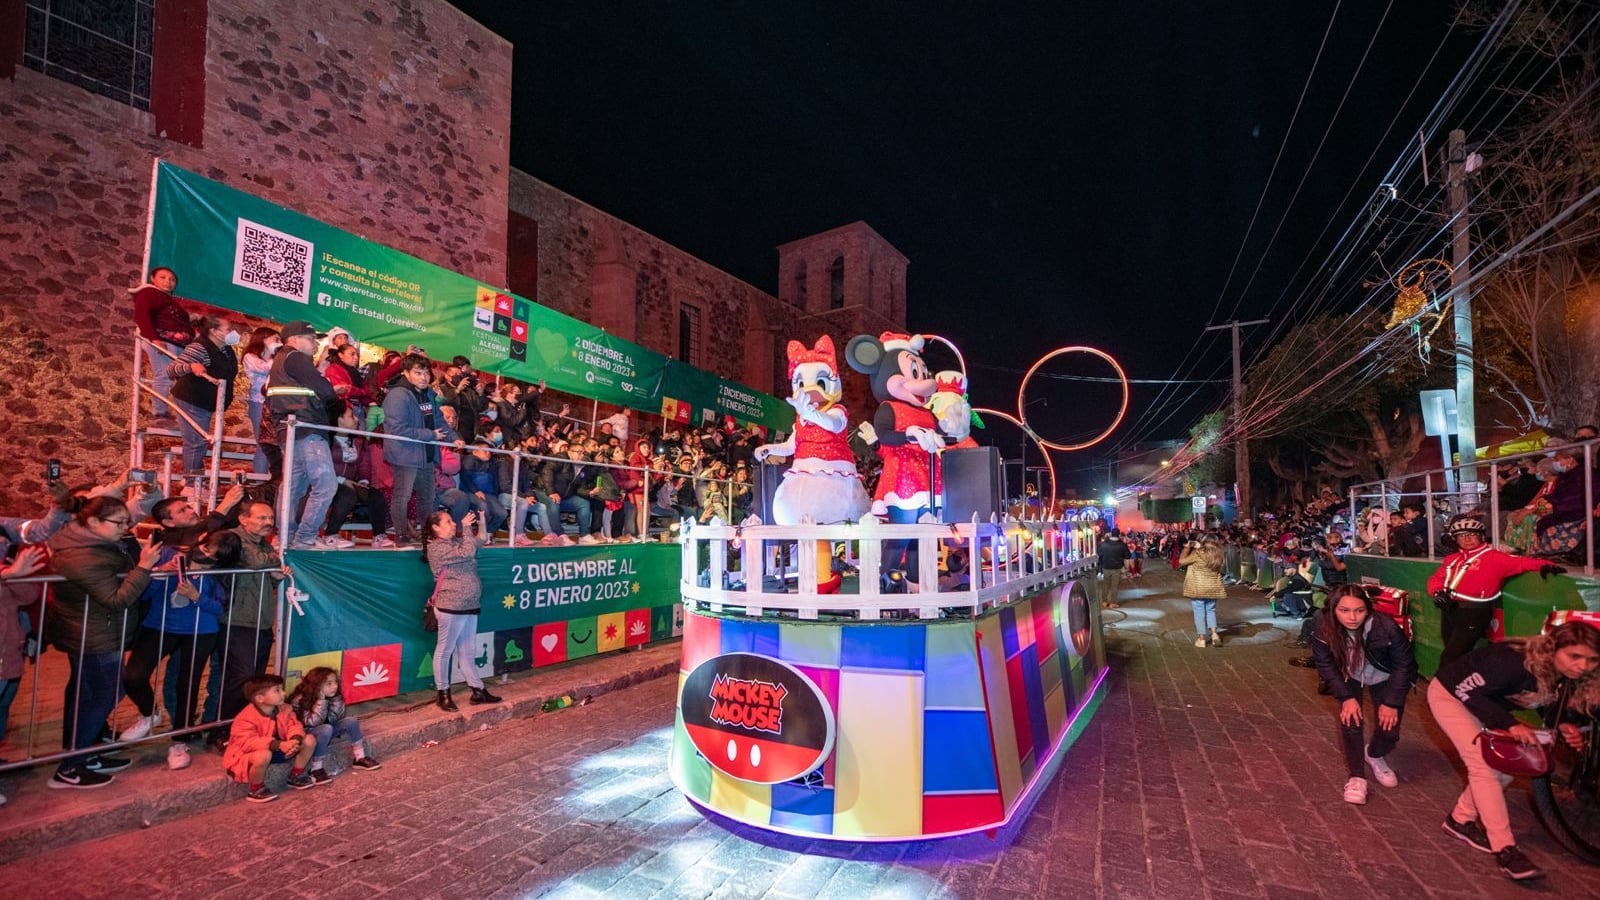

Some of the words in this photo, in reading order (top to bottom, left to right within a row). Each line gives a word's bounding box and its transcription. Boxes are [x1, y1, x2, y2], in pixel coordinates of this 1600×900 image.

[320, 264, 327, 273] y
[328, 266, 371, 287] consulta
[371, 279, 380, 289] la
[322, 252, 366, 274] ¡Escanea
[368, 270, 377, 278] el
[378, 273, 407, 288] código
[334, 298, 351, 310] DIF
[351, 304, 385, 321] Estatal
[385, 313, 427, 332] Querétaro
[575, 336, 582, 348] 2
[582, 339, 625, 363] DICIEMBRE
[624, 355, 635, 367] AL
[577, 351, 584, 361] 8
[584, 353, 612, 371] ENERO
[612, 363, 631, 378] 2023
[719, 384, 724, 394] 2
[724, 386, 755, 405] DICIEMBRE
[755, 398, 762, 408] AL
[726, 399, 745, 413] ENERO
[511, 564, 524, 584] 2
[527, 558, 617, 583] DICIEMBRE
[618, 558, 637, 575] AL
[519, 590, 531, 610] 8
[534, 584, 592, 608] ENERO
[595, 580, 630, 601] 2023
[710, 675, 787, 708] MICKEY
[710, 699, 782, 733] MOUSE
